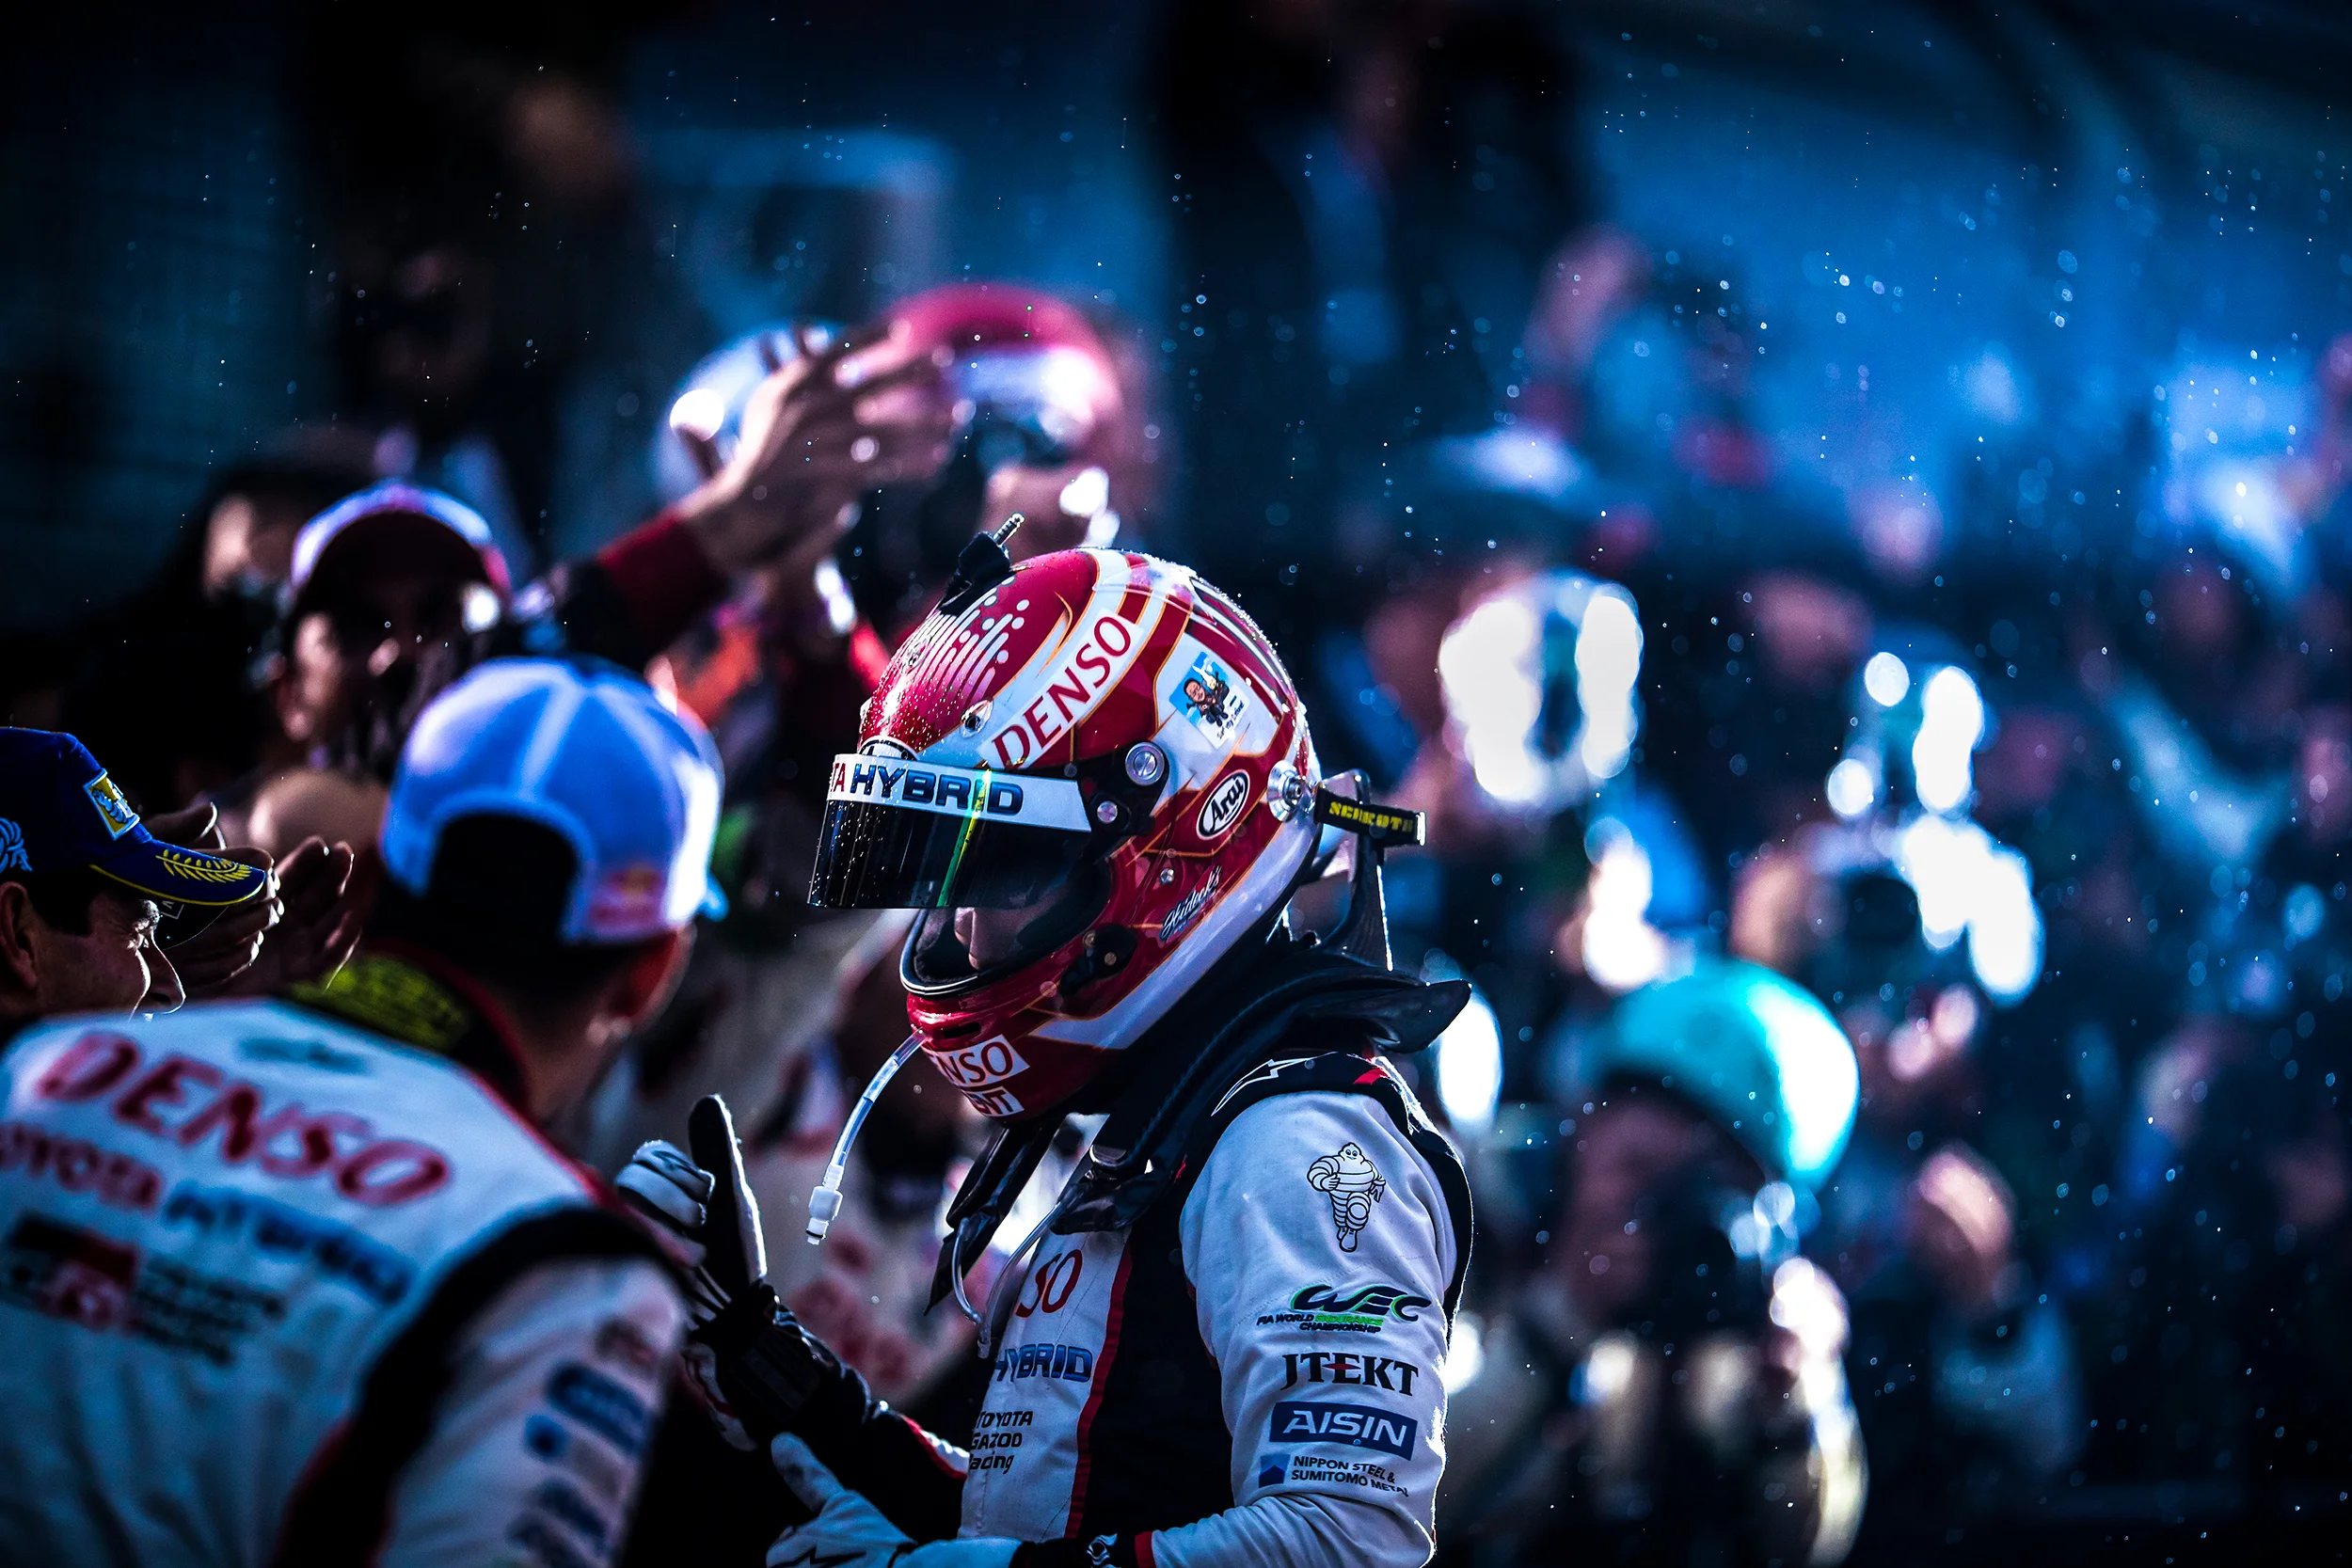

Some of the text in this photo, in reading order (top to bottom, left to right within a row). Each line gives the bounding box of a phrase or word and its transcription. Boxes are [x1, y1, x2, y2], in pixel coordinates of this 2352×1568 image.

[992, 616, 1132, 770] DENSO
[850, 763, 1024, 816] HYBRID
[1209, 775, 1245, 833] Arai
[926, 1041, 1014, 1085] NSO
[36, 1029, 453, 1208] DENSO
[1256, 1313, 1384, 1326] FIA WORLD ENDURANCE
[1290, 1283, 1433, 1323] WEC
[1299, 1322, 1381, 1334] CHAMPIONSHIP
[995, 1342, 1093, 1383] HYBRID
[1280, 1352, 1419, 1397] JTEKT
[976, 1411, 1034, 1429] TOYOTA
[1282, 1410, 1407, 1448] AISIN
[971, 1432, 1023, 1449] GAZOO
[1291, 1469, 1410, 1497] SUMITOMO METAL
[1294, 1455, 1397, 1484] NIPPON STEEL &
